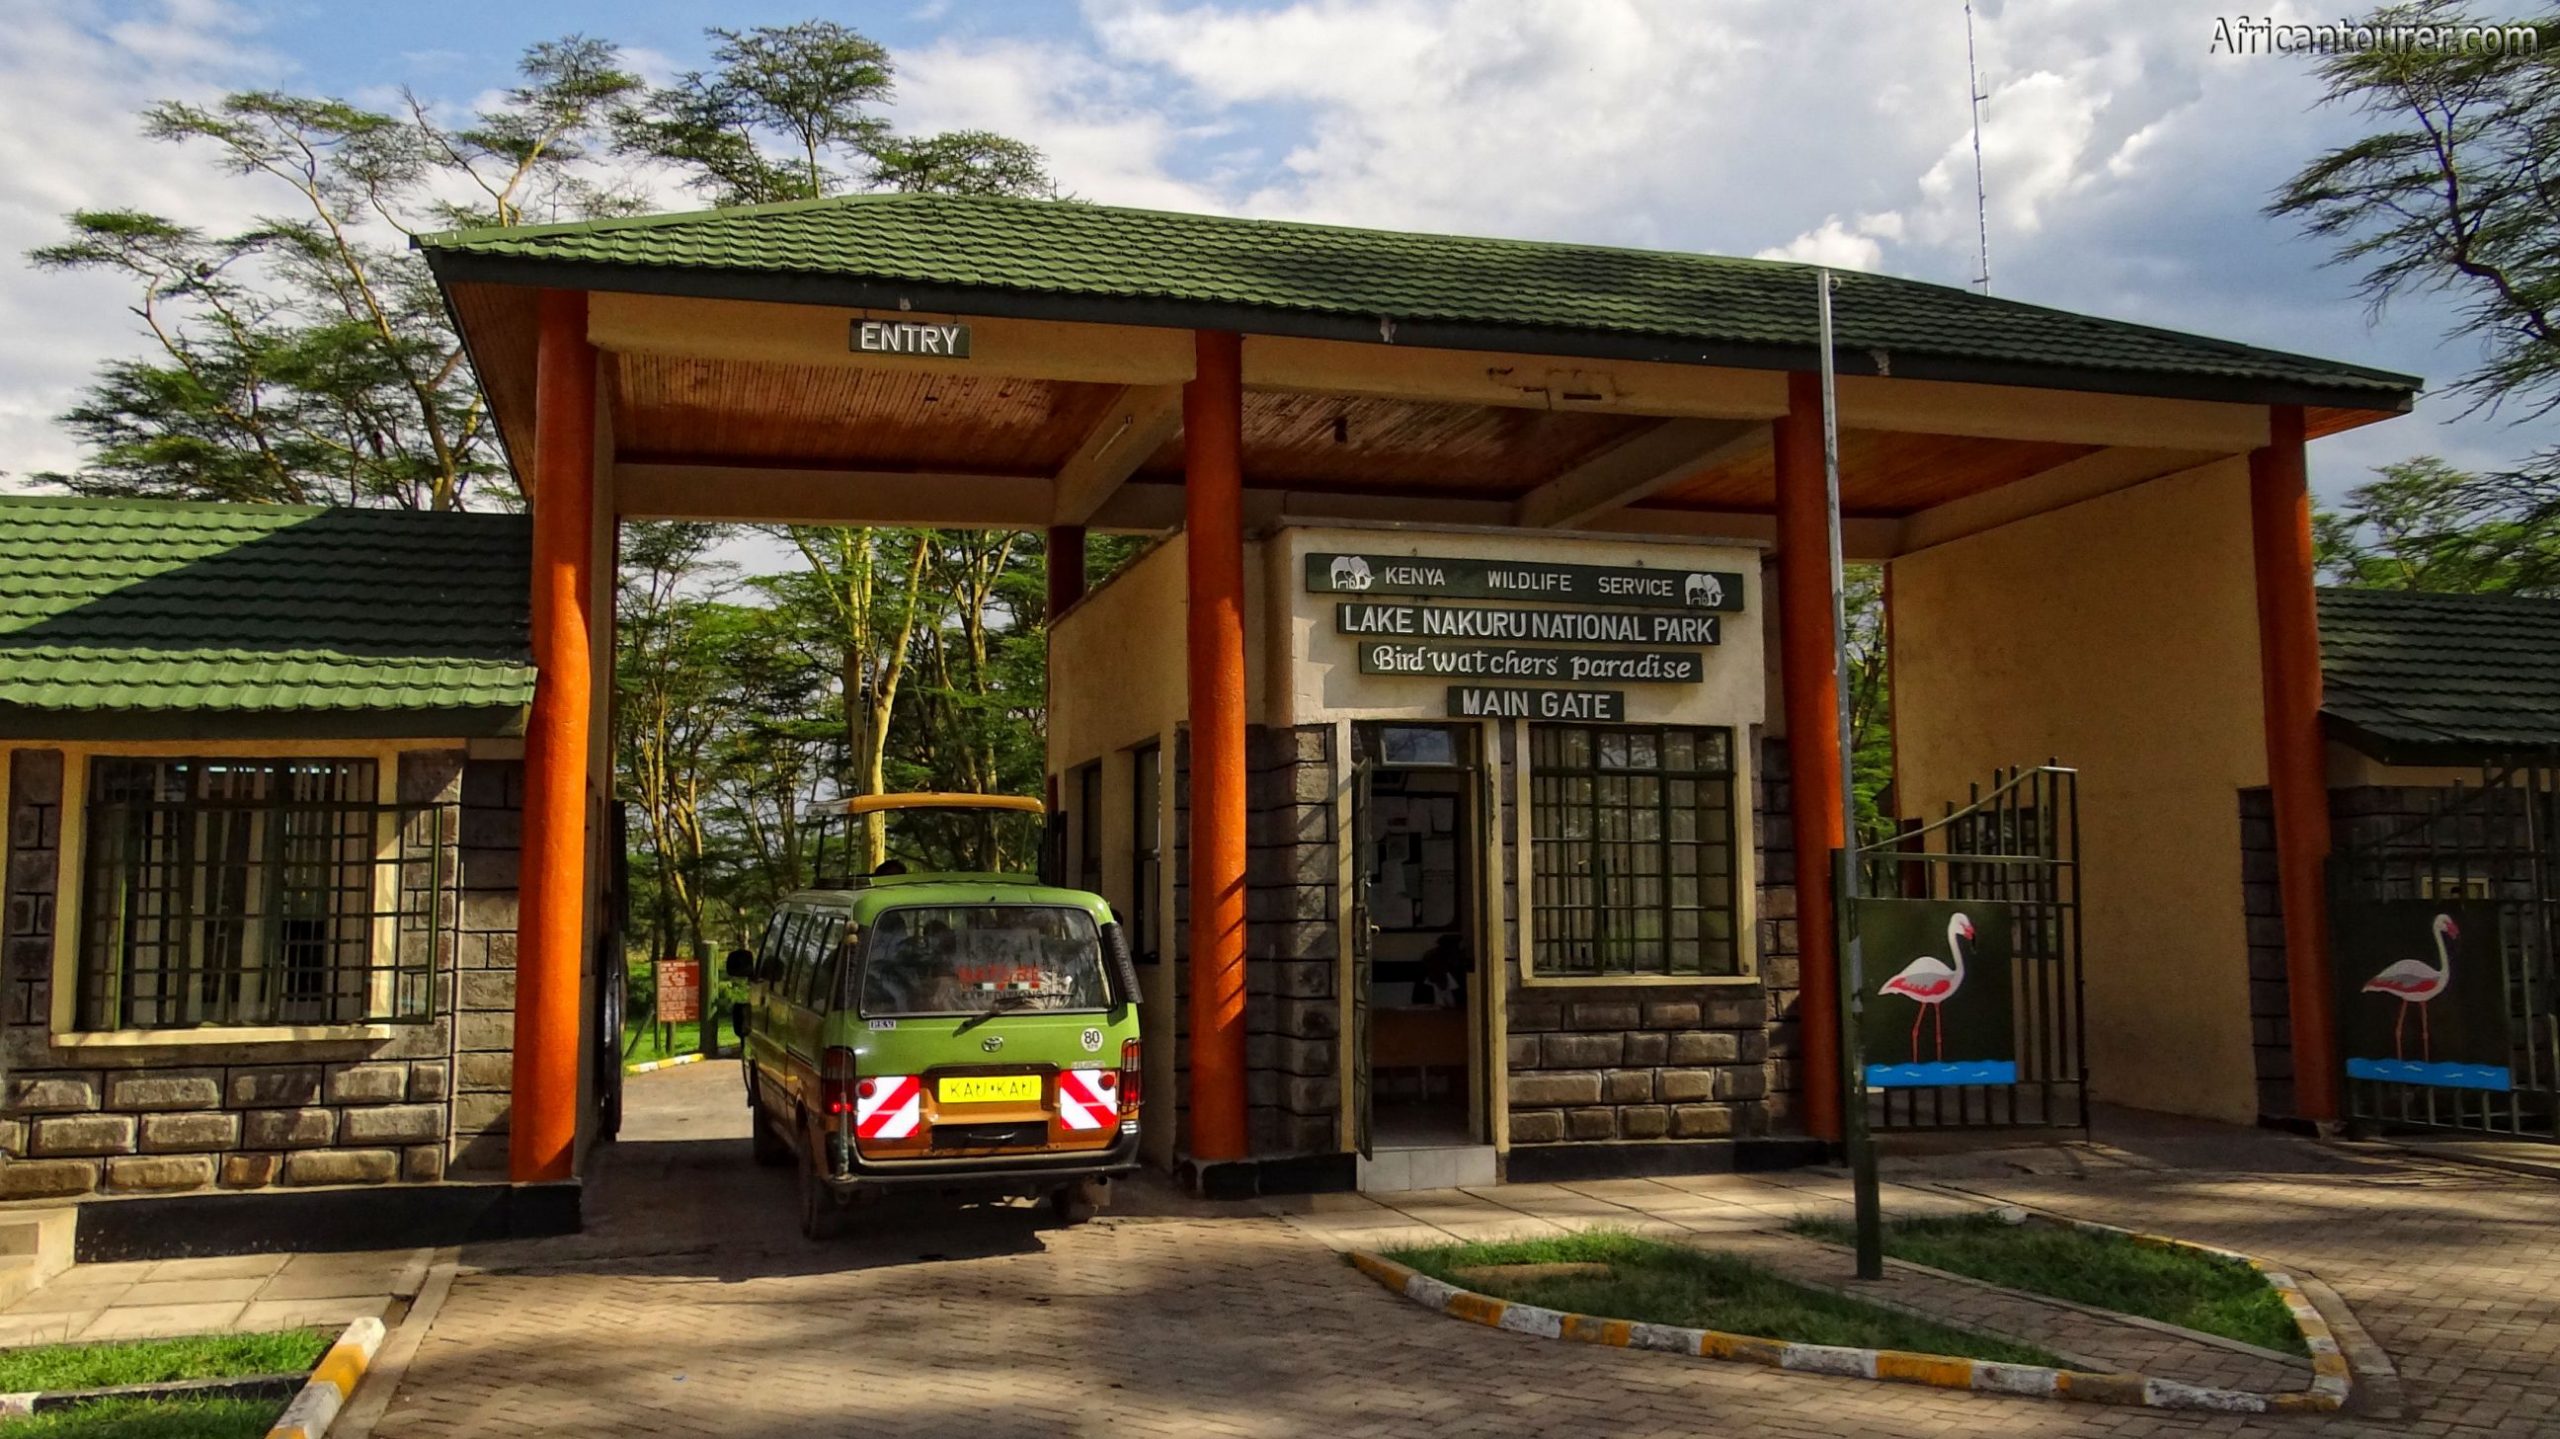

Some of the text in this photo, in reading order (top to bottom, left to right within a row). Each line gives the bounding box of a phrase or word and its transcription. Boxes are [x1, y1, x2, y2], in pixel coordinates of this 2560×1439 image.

[861, 321, 960, 355] ENTRY
[1385, 566, 1674, 597] KENYA WILDLIFE SERVICE
[1345, 605, 1713, 643] LAKE NAKURU NATIONAL PARK
[1373, 645, 1427, 671] Bird
[1570, 654, 1692, 680] paradise
[1462, 689, 1611, 719] MAIN GATE
[1084, 1031, 1100, 1045] 80
